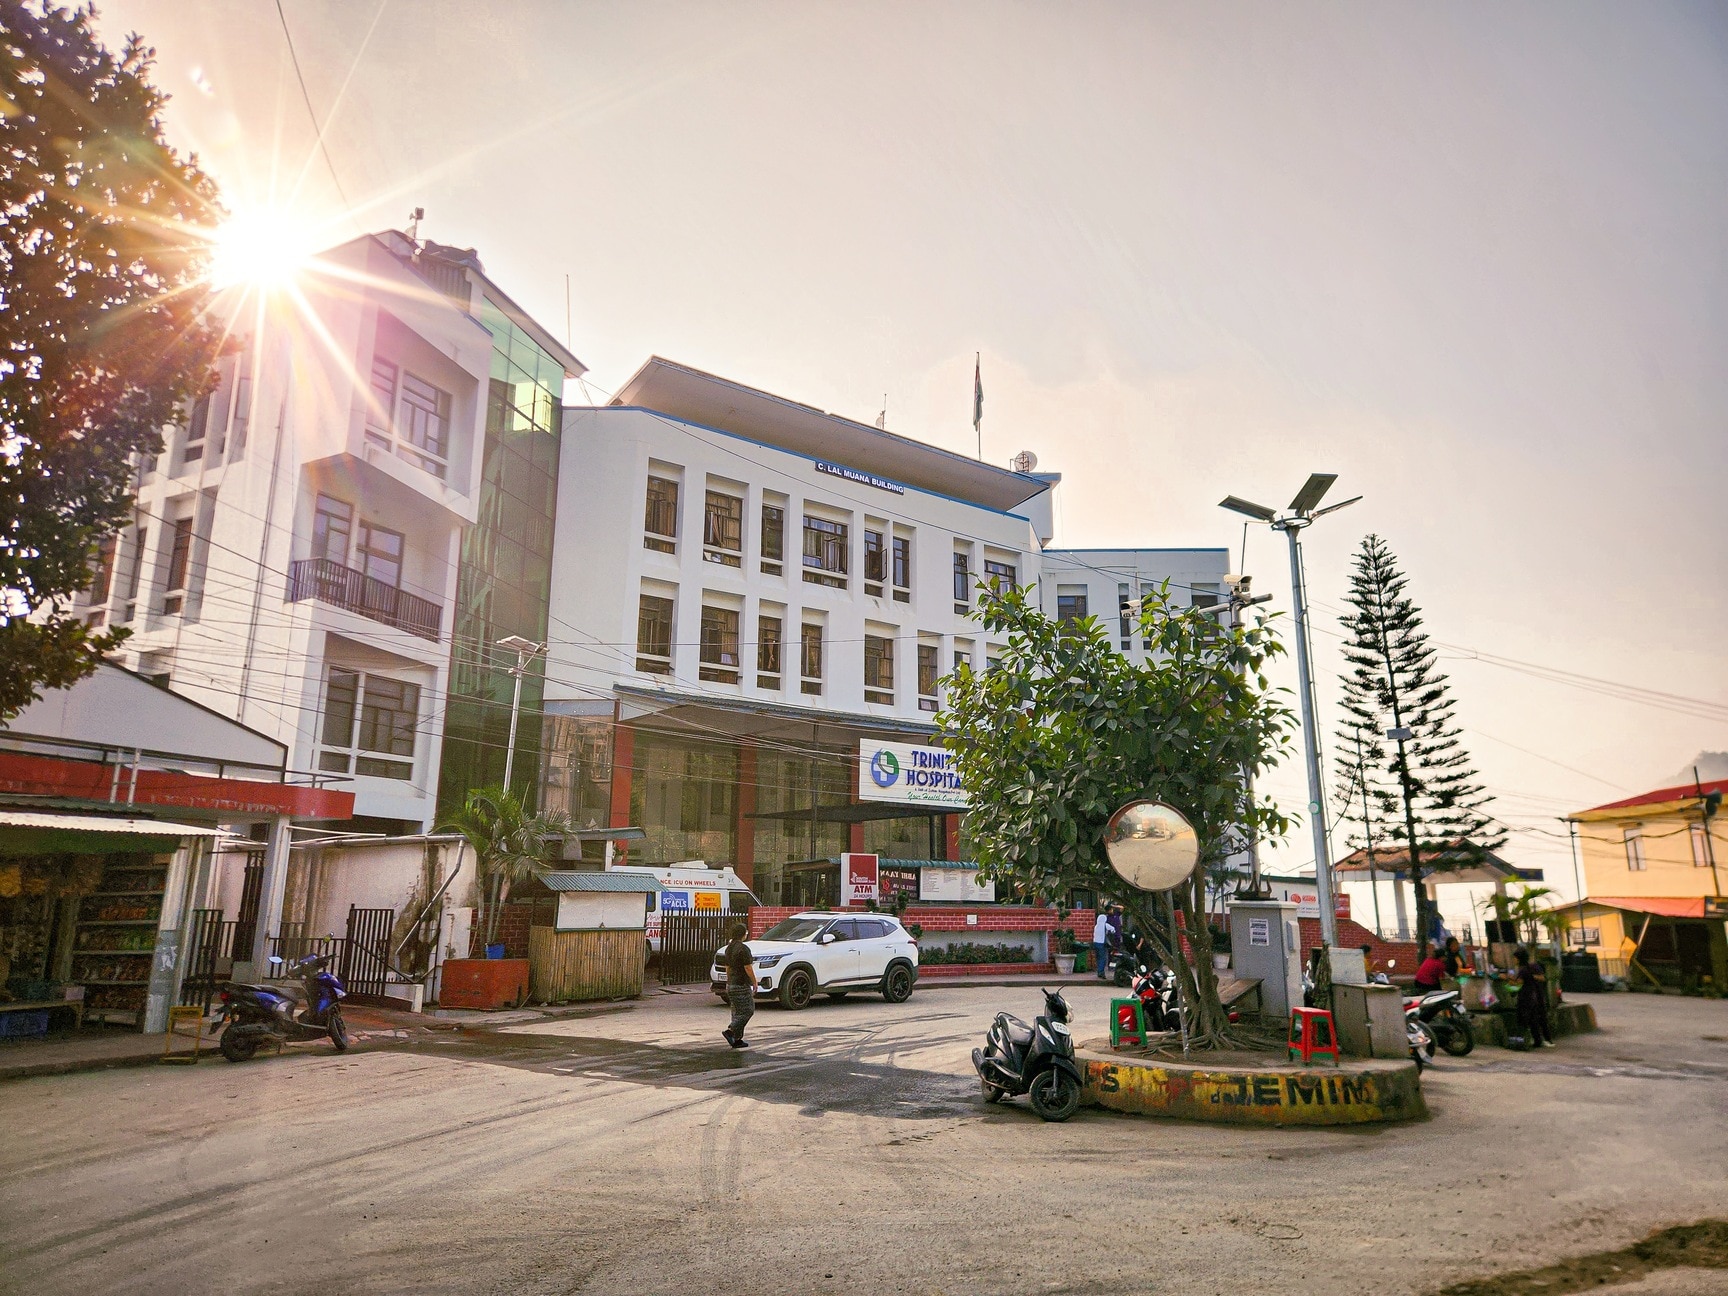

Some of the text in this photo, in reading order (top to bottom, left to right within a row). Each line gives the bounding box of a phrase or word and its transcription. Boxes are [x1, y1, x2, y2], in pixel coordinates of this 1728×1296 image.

[818, 463, 904, 493] C. LAL MUANA BUILDING
[906, 769, 967, 790] HOSPITA
[853, 885, 873, 893] ATM
[671, 899, 687, 908] ACLS
